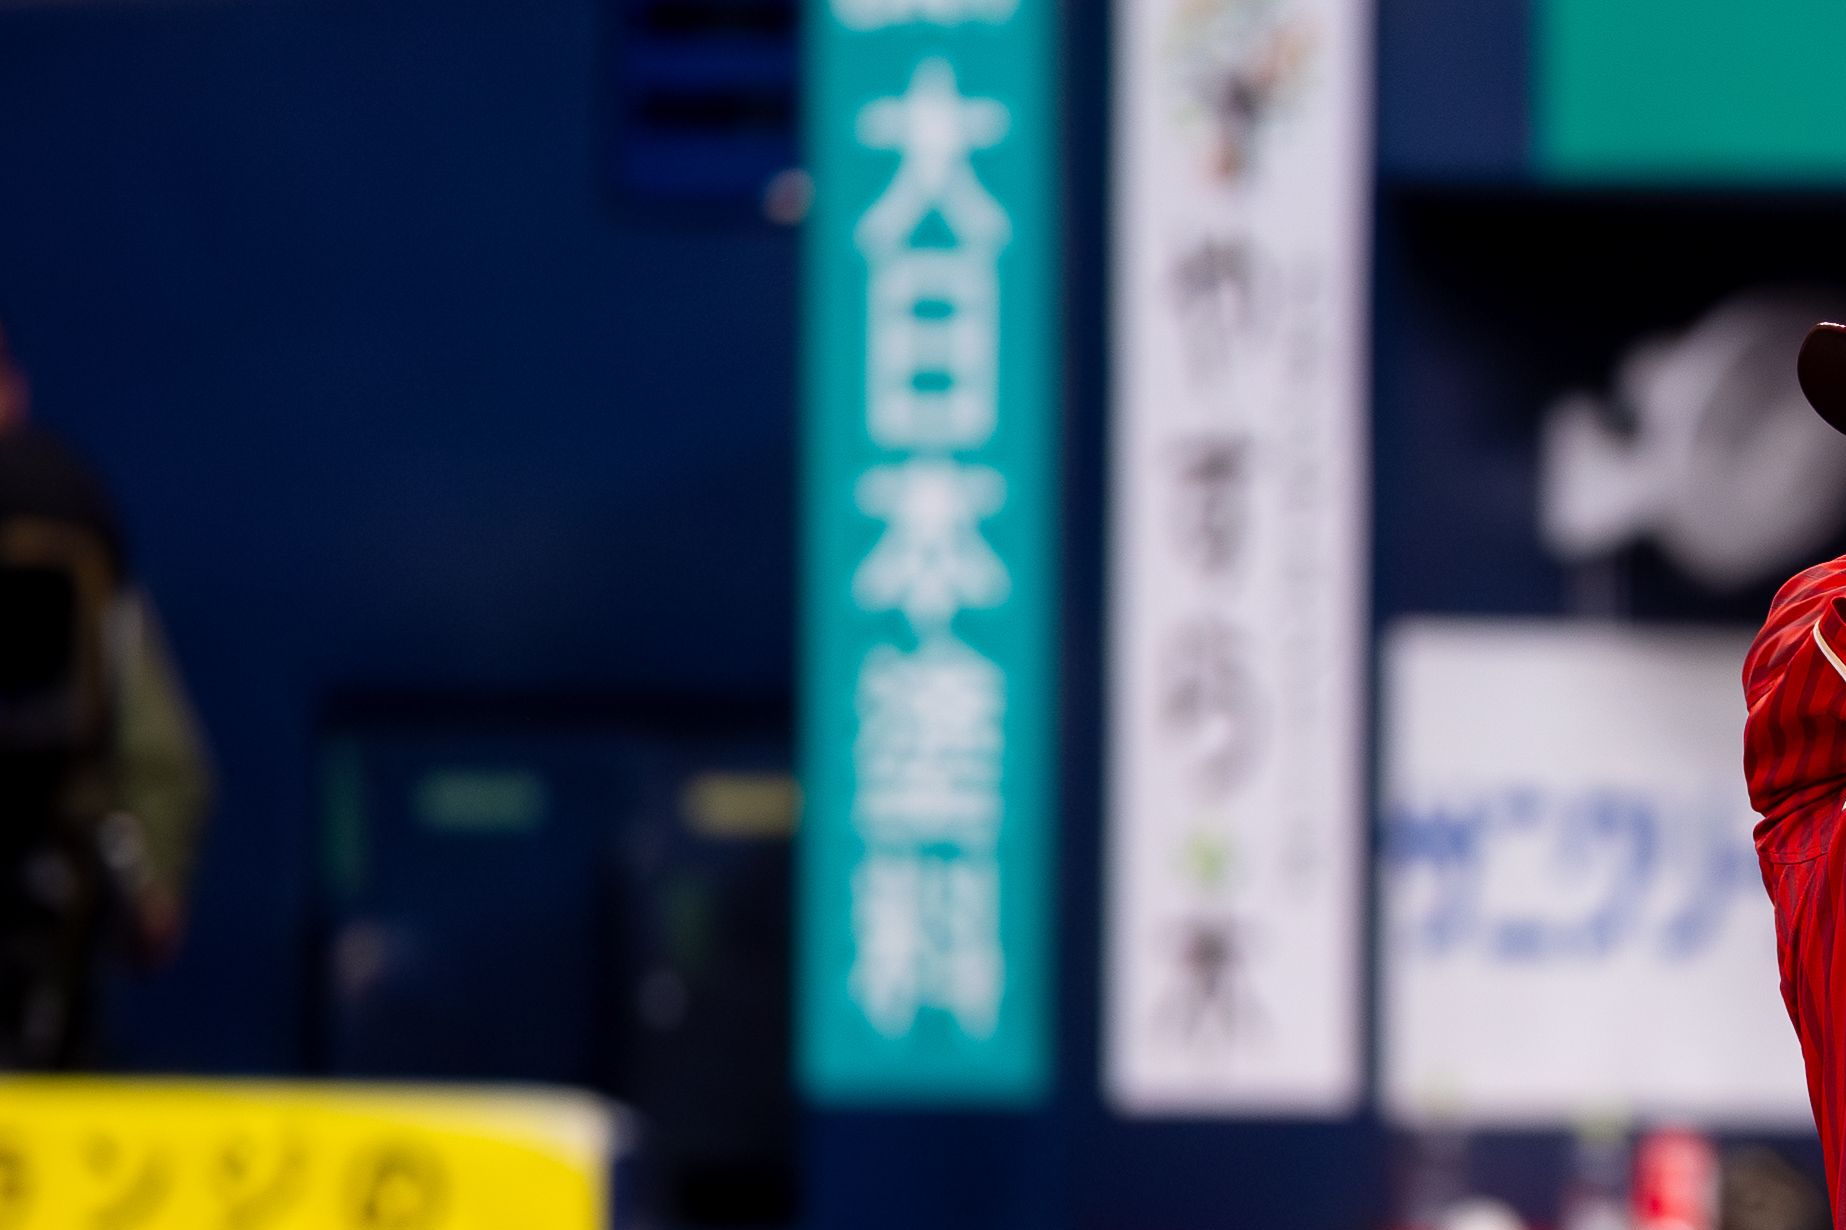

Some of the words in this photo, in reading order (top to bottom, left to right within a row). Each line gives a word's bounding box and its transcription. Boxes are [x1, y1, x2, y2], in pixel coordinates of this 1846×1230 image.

[832, 0, 1010, 1040] 大日本塗料
